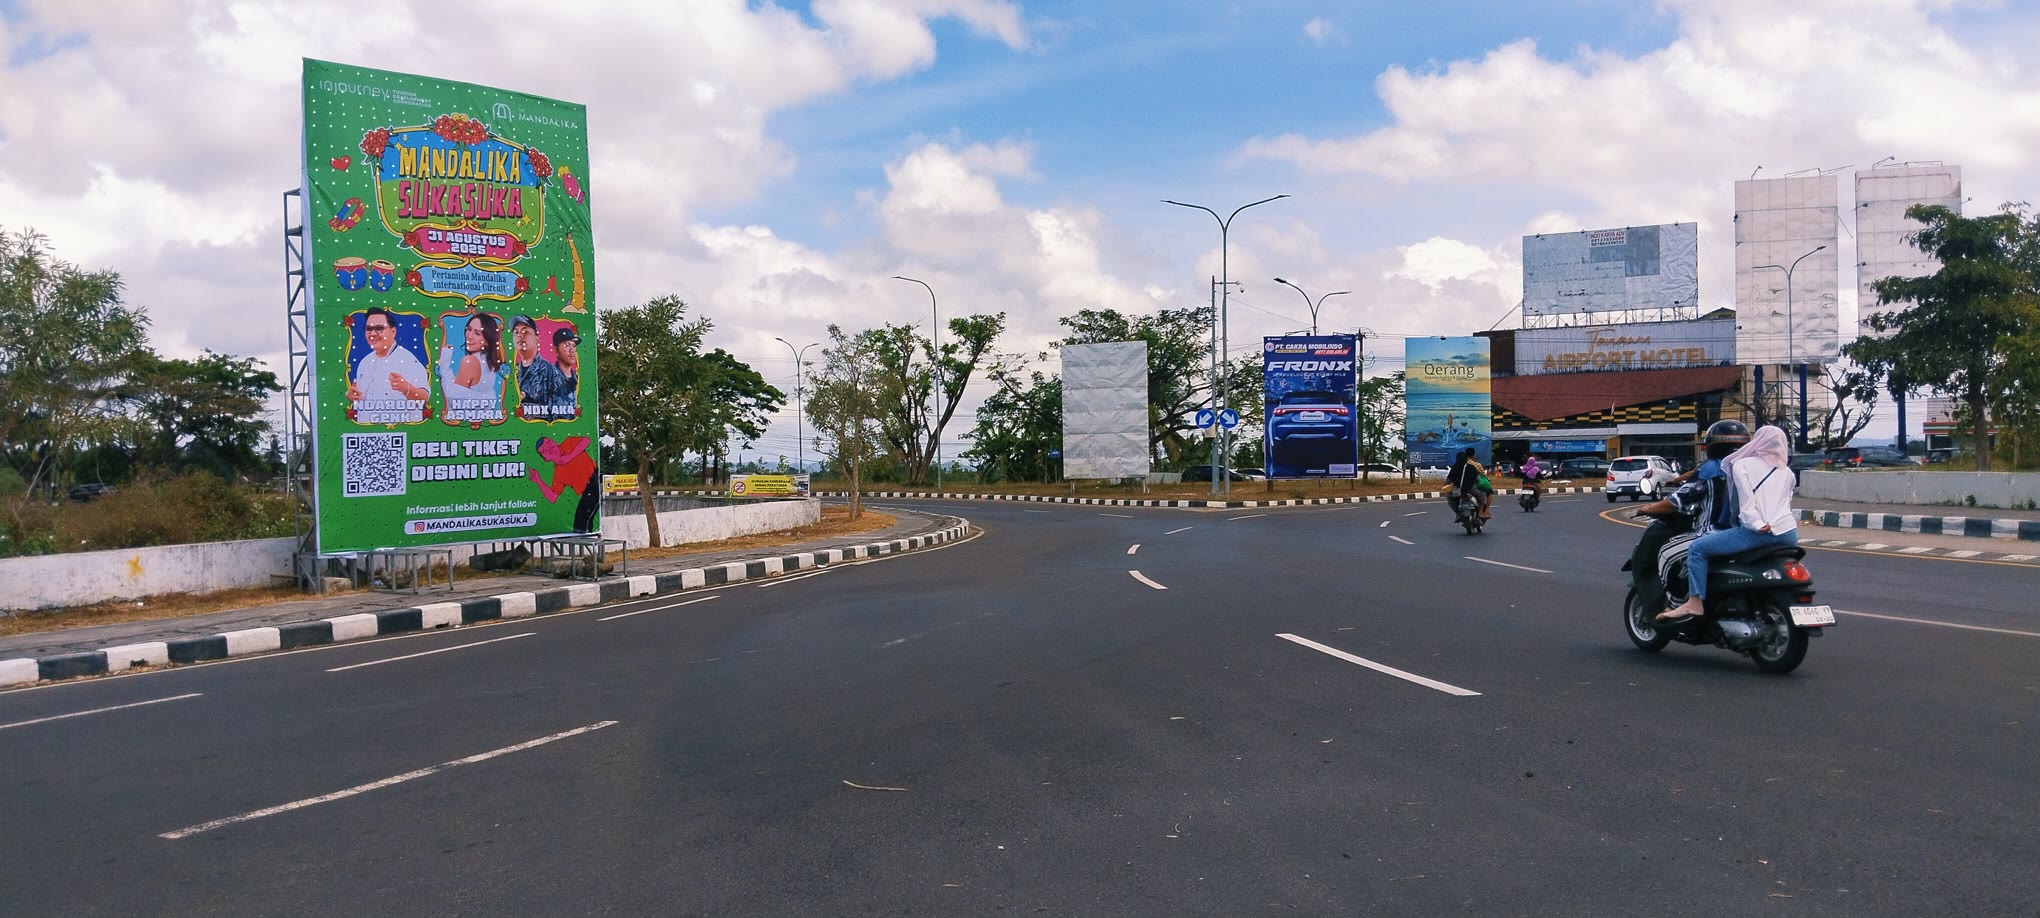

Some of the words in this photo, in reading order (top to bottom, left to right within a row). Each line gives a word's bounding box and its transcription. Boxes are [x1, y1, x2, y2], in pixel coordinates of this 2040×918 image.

[519, 113, 578, 129] MANDALIKA
[399, 145, 521, 184] MANDALIKA
[398, 180, 523, 220] SUKASUKA
[428, 230, 443, 242] 31
[445, 232, 506, 248] AGUSTUS
[450, 242, 487, 256] 2025
[431, 269, 470, 281] Pertamina
[471, 273, 507, 283] Mandalika
[482, 282, 507, 293] Circuit
[1542, 350, 1635, 369] AIRPORT
[1640, 347, 1711, 365] HOTEL
[1267, 361, 1353, 372] FRONX
[1424, 364, 1474, 378] Qerang
[452, 400, 496, 410] HAPPY
[523, 405, 549, 415] NDX
[551, 405, 575, 414] AKA
[445, 409, 504, 420] ASMARA
[411, 441, 458, 459] BELI
[462, 439, 521, 457] TIKET
[411, 463, 478, 482] DISINI
[482, 461, 526, 479] LUR!
[406, 504, 453, 515] Informasi
[455, 502, 479, 512] lebih
[480, 501, 507, 512] lanjut
[508, 500, 537, 509] follow:
[426, 515, 528, 531] MANDALIKASUKASUKA
